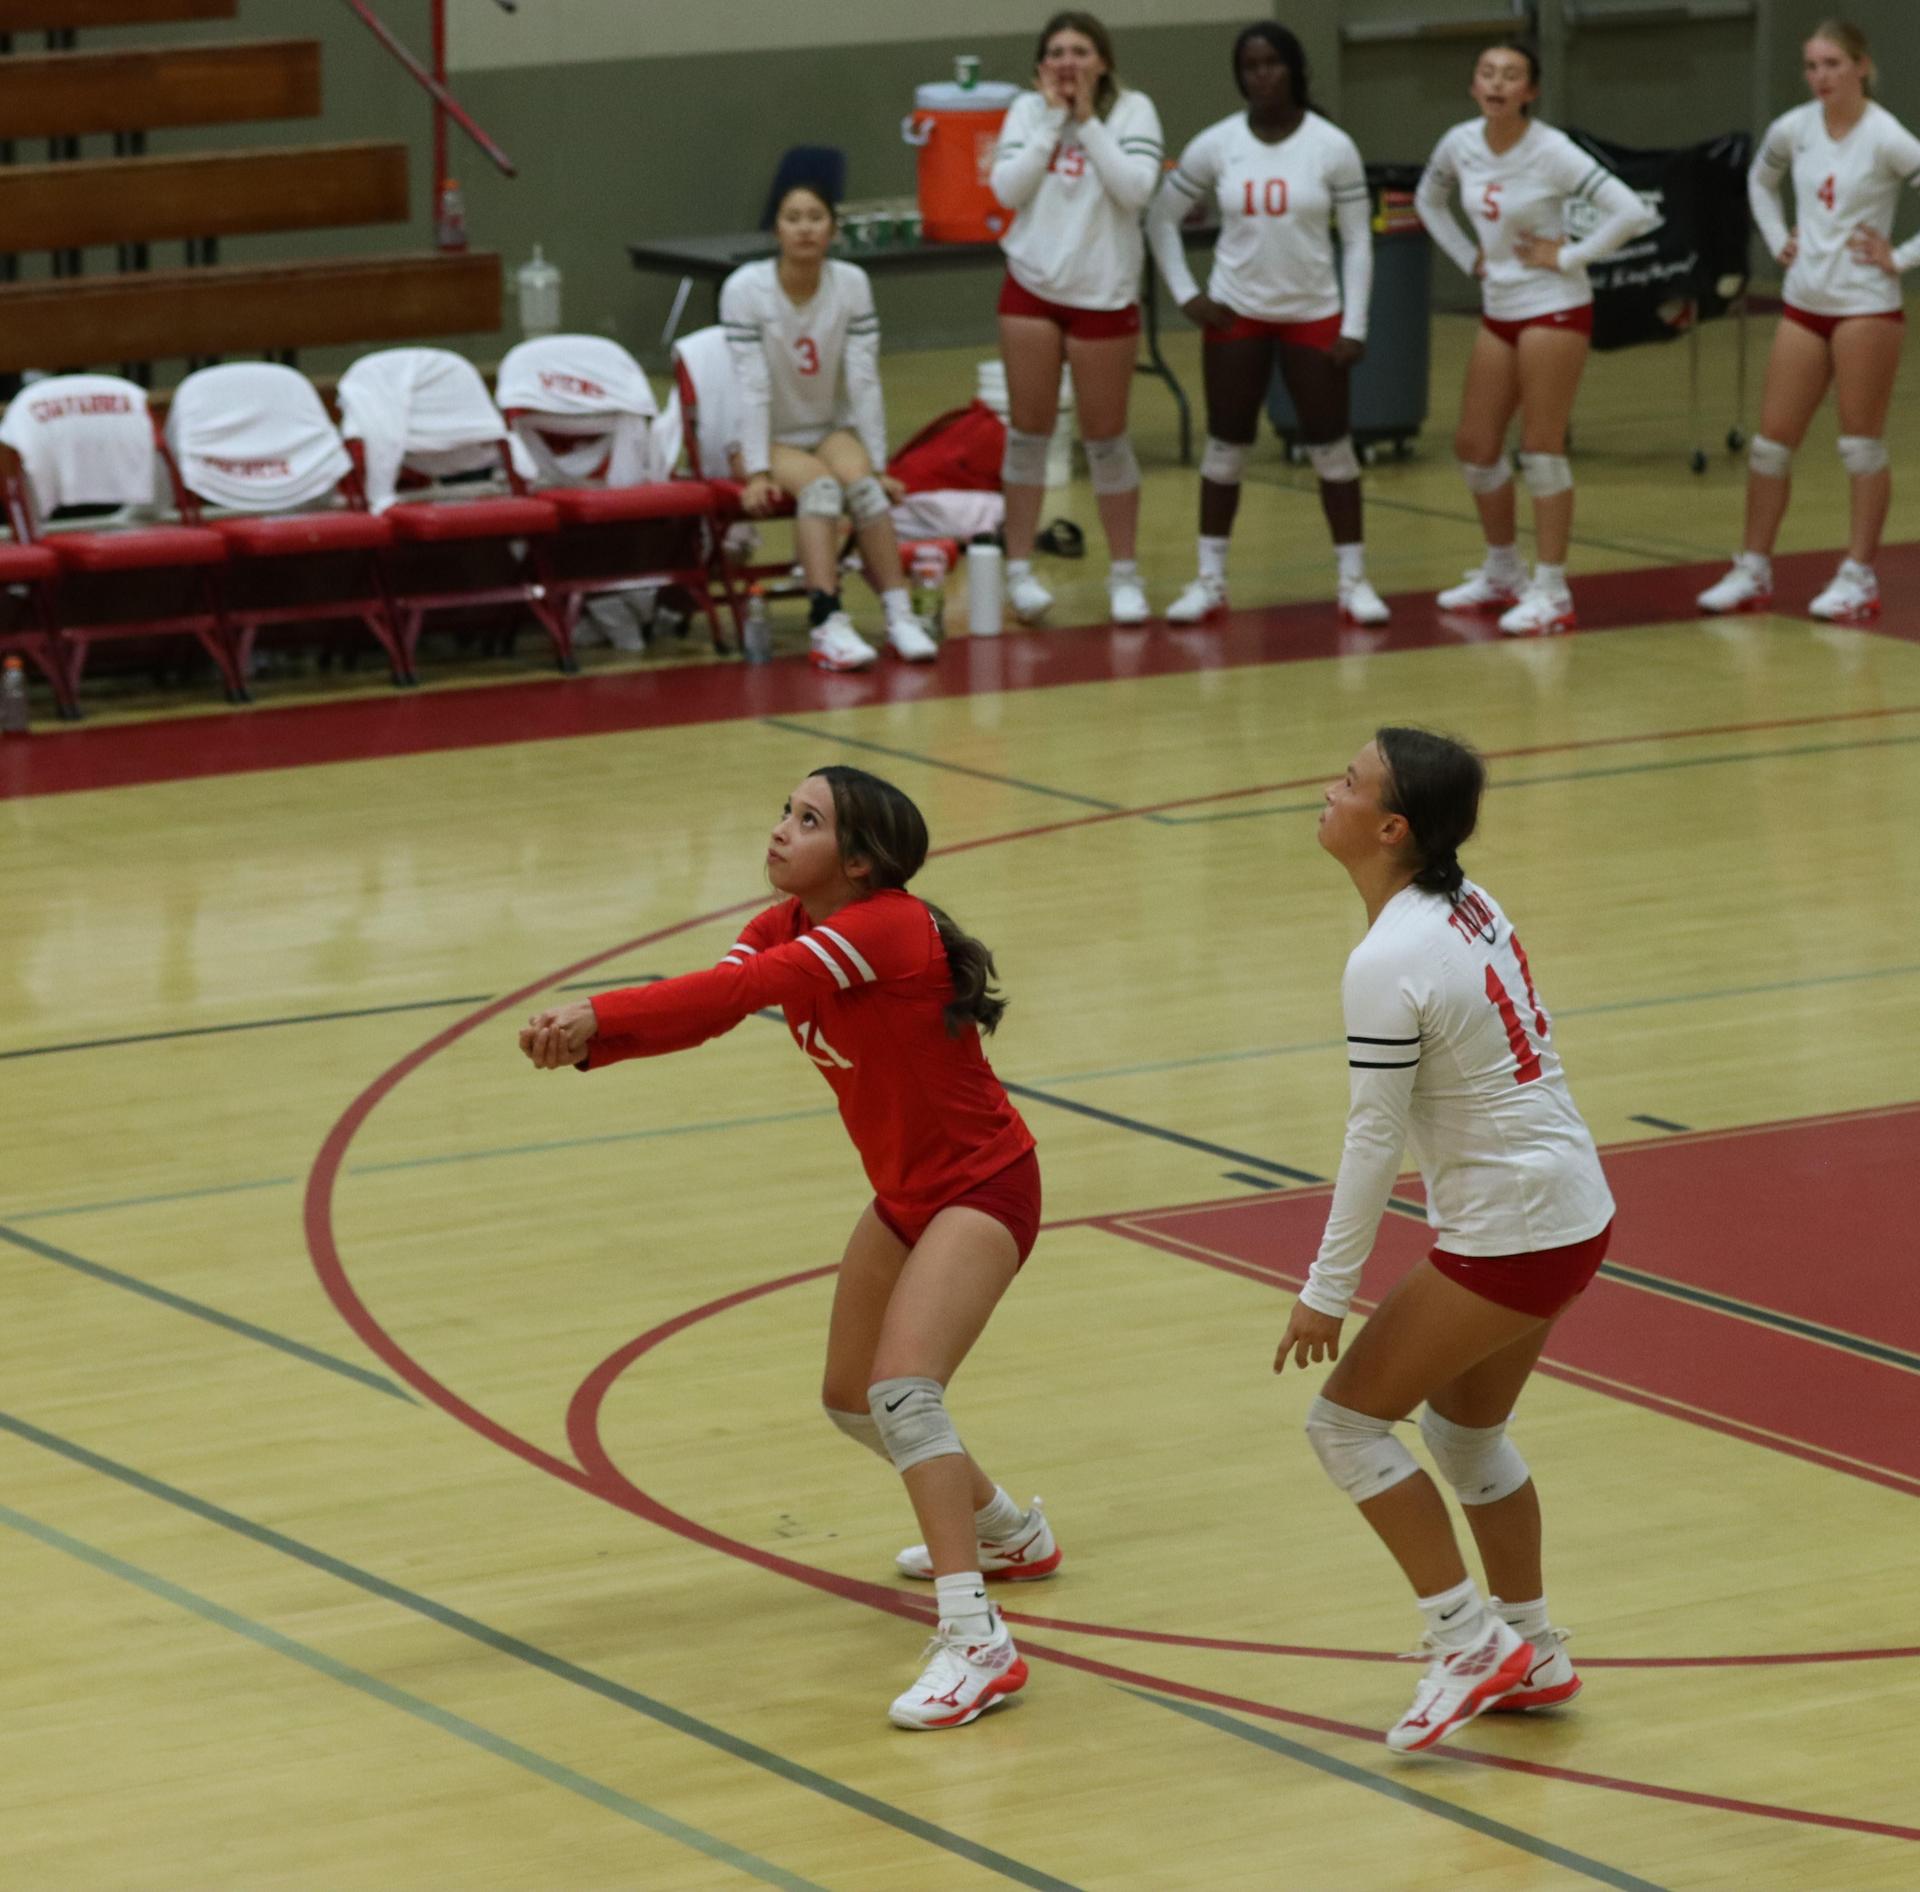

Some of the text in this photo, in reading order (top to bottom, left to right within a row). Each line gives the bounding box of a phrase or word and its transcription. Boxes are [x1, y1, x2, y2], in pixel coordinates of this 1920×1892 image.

[1243, 178, 1288, 216] 10
[1482, 183, 1502, 222] 5
[1817, 174, 1834, 211] 4
[793, 336, 819, 377] 3
